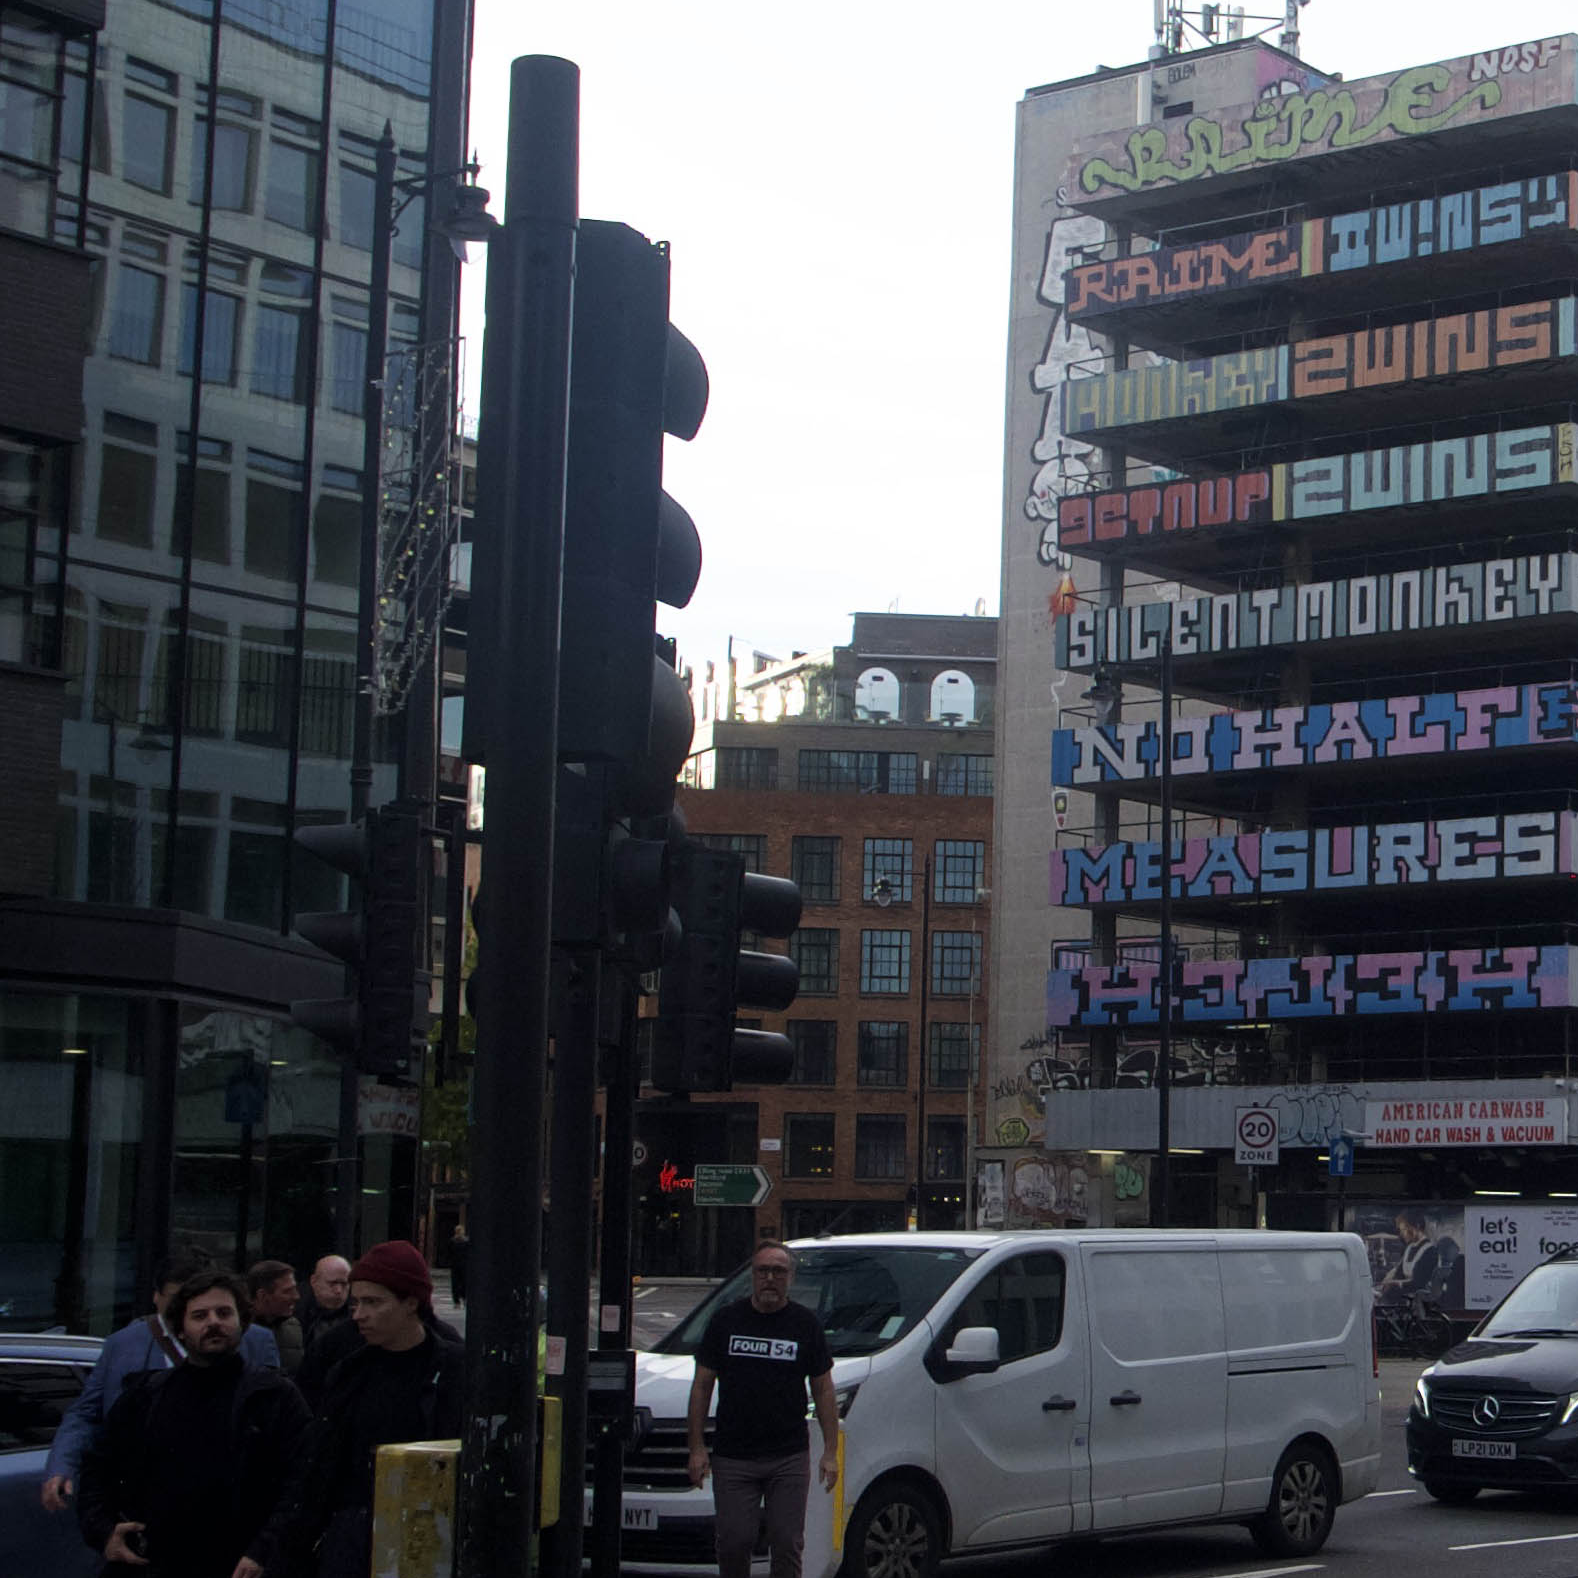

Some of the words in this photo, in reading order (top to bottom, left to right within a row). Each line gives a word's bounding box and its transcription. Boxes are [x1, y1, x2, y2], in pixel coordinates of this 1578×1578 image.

[1067, 587, 1281, 667] SILENT
[1297, 554, 1560, 640] MONKEY
[1074, 720, 1209, 783] NO
[1233, 686, 1518, 771] HALF
[1064, 812, 1558, 904] MEASURES
[1382, 1100, 1464, 1122] AMERICAN
[1469, 1099, 1546, 1120] CARWASH
[1245, 1121, 1271, 1138] 20
[1375, 1128, 1411, 1144] HAND
[1415, 1127, 1441, 1143] CAR
[1446, 1126, 1482, 1142] WASH
[1486, 1126, 1496, 1142] &
[1501, 1125, 1555, 1141] VACUUM
[1239, 1150, 1274, 1162] ZONE
[1480, 1216, 1518, 1235] let's
[1479, 1236, 1518, 1254] eat!
[733, 1339, 769, 1354] FOUR
[775, 1342, 795, 1357] 54
[624, 1509, 651, 1527] NYT
